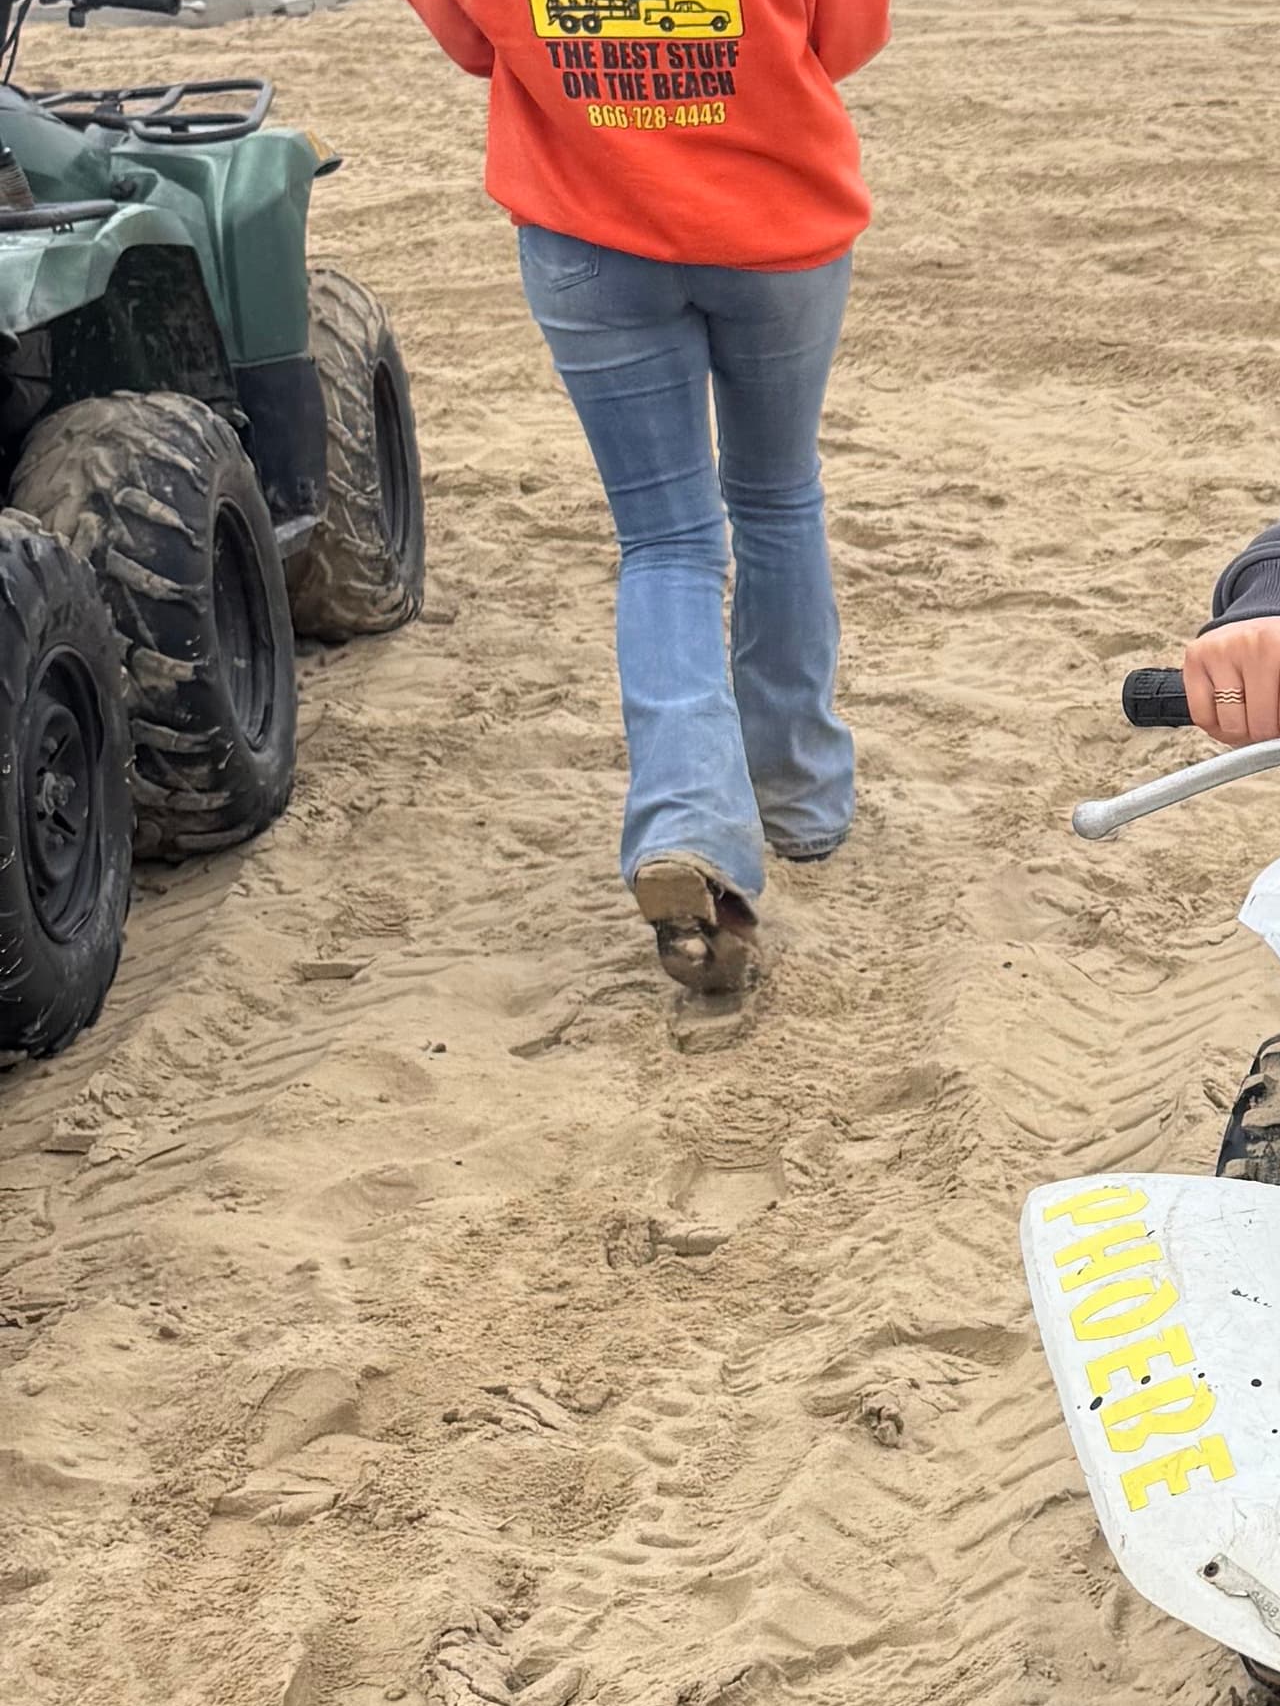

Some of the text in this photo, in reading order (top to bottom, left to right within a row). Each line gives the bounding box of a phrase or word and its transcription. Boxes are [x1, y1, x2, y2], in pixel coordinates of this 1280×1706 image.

[546, 40, 740, 70] THE BEST STUFF
[563, 70, 736, 100] ON THE BEACH
[586, 101, 727, 131] 866-728-4443
[1043, 1184, 1238, 1513] PHOEBE
